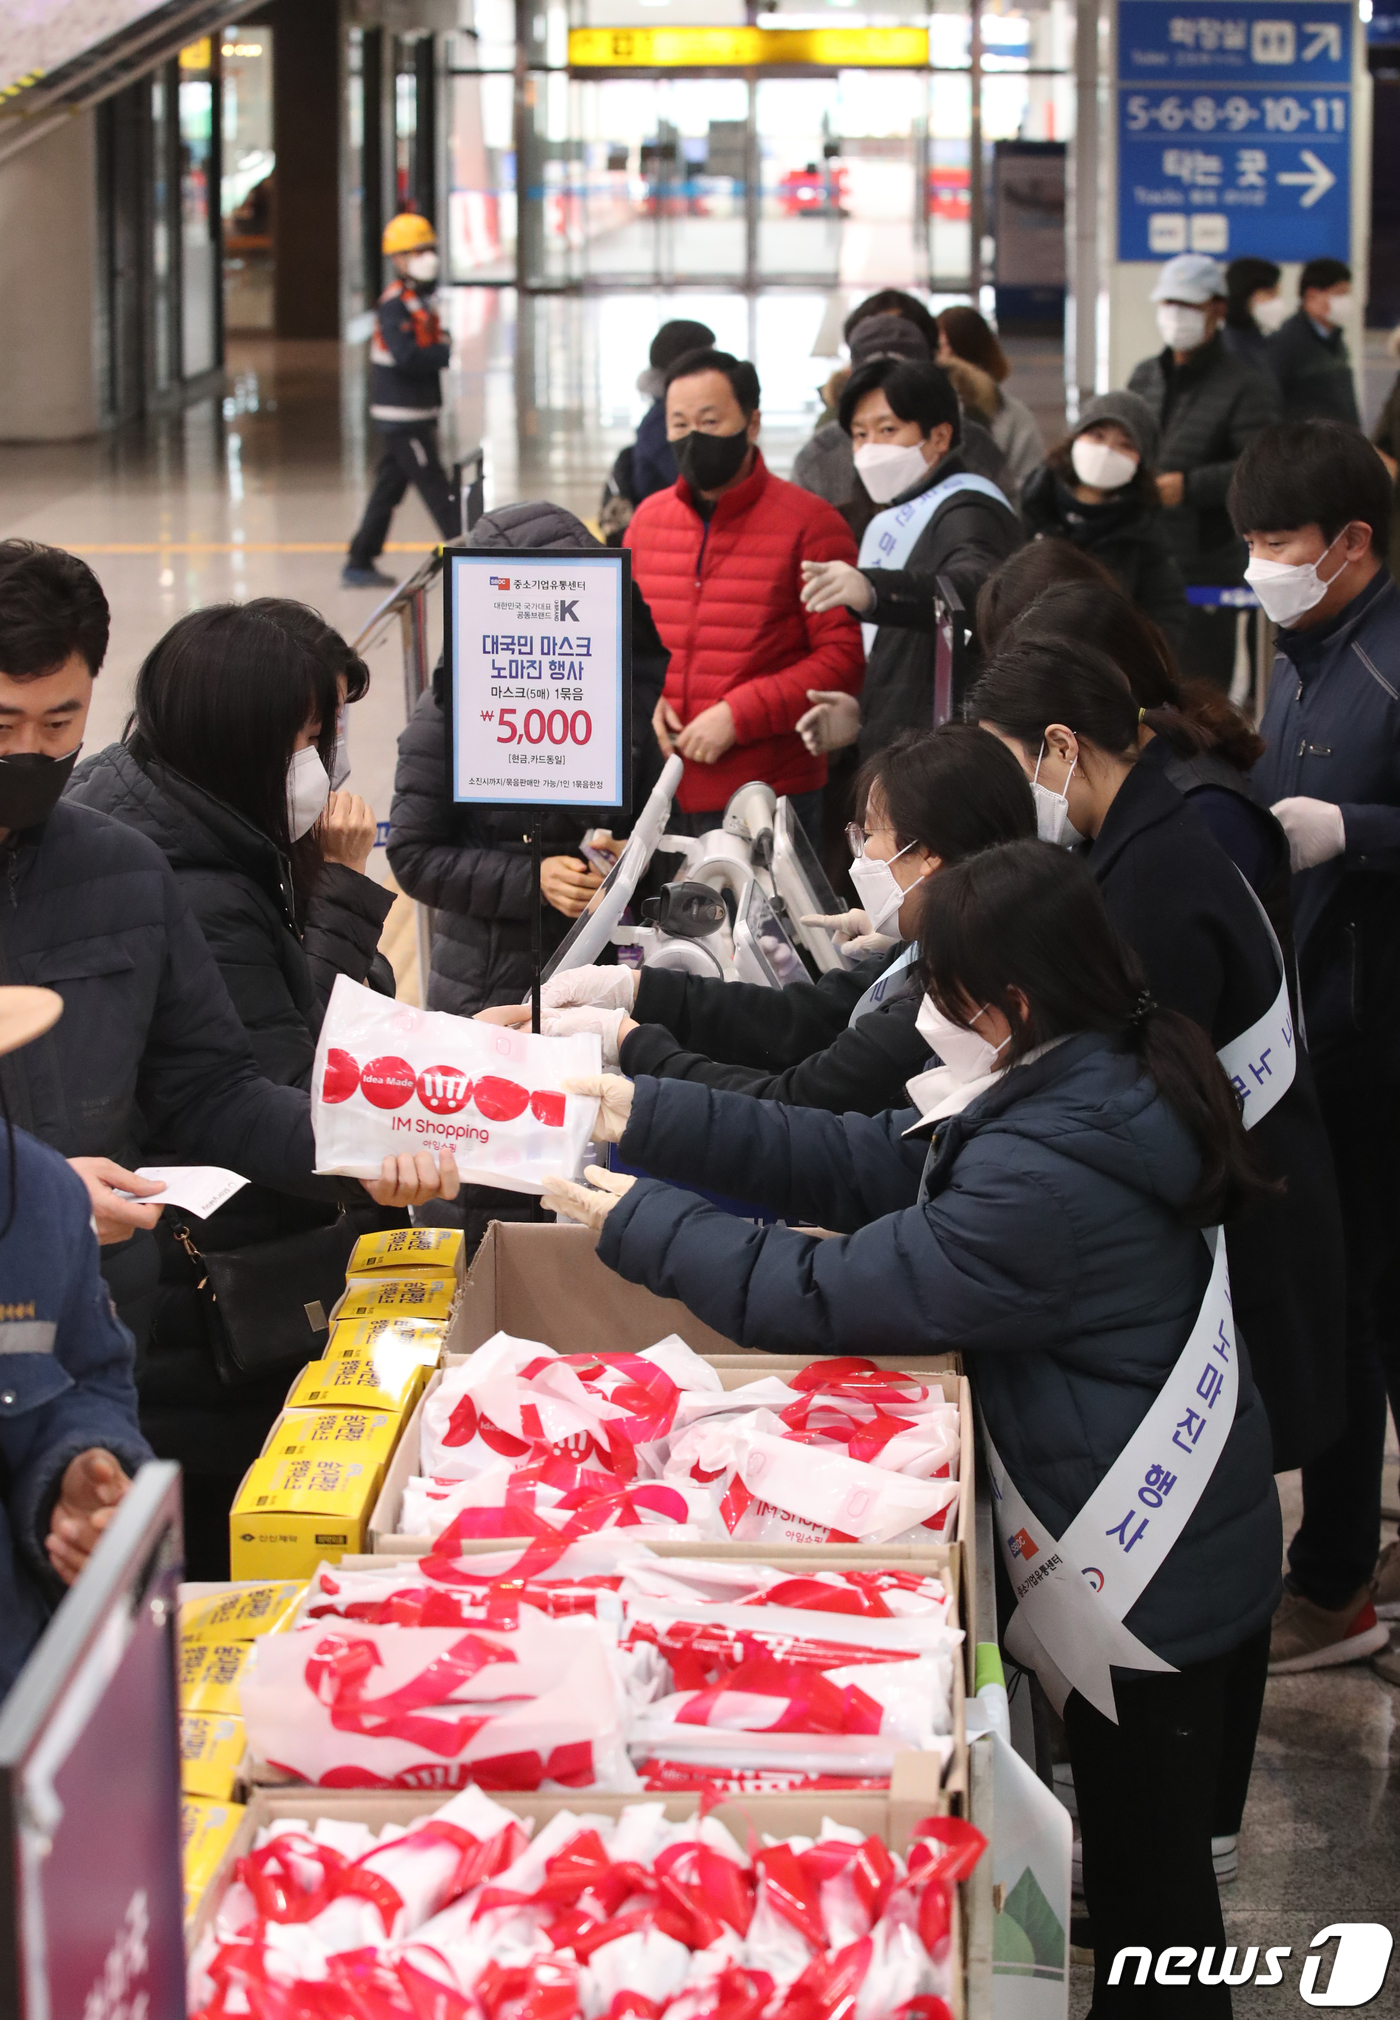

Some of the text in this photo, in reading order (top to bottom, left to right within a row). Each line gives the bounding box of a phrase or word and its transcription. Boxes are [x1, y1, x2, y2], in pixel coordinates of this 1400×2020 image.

[513, 579, 586, 591] 중소기업유통센터
[494, 601, 552, 611] 대한민국 국가대표
[560, 600, 580, 622] K
[517, 611, 552, 620] 공동브랜드
[482, 635, 592, 657] 대국민 마스크
[491, 659, 584, 681] 노마진 행사
[491, 686, 584, 701] 마스크(5매) 1묶음
[468, 778, 604, 790] 소진시까지/묶음판매만 가능/1인 1묶음한정
[363, 1074, 414, 1088] Idea Made
[392, 1116, 489, 1144] IM Shopping
[1105, 1319, 1231, 1554] 노마진 행사
[1017, 1553, 1063, 1598] 중소기업유통센터
